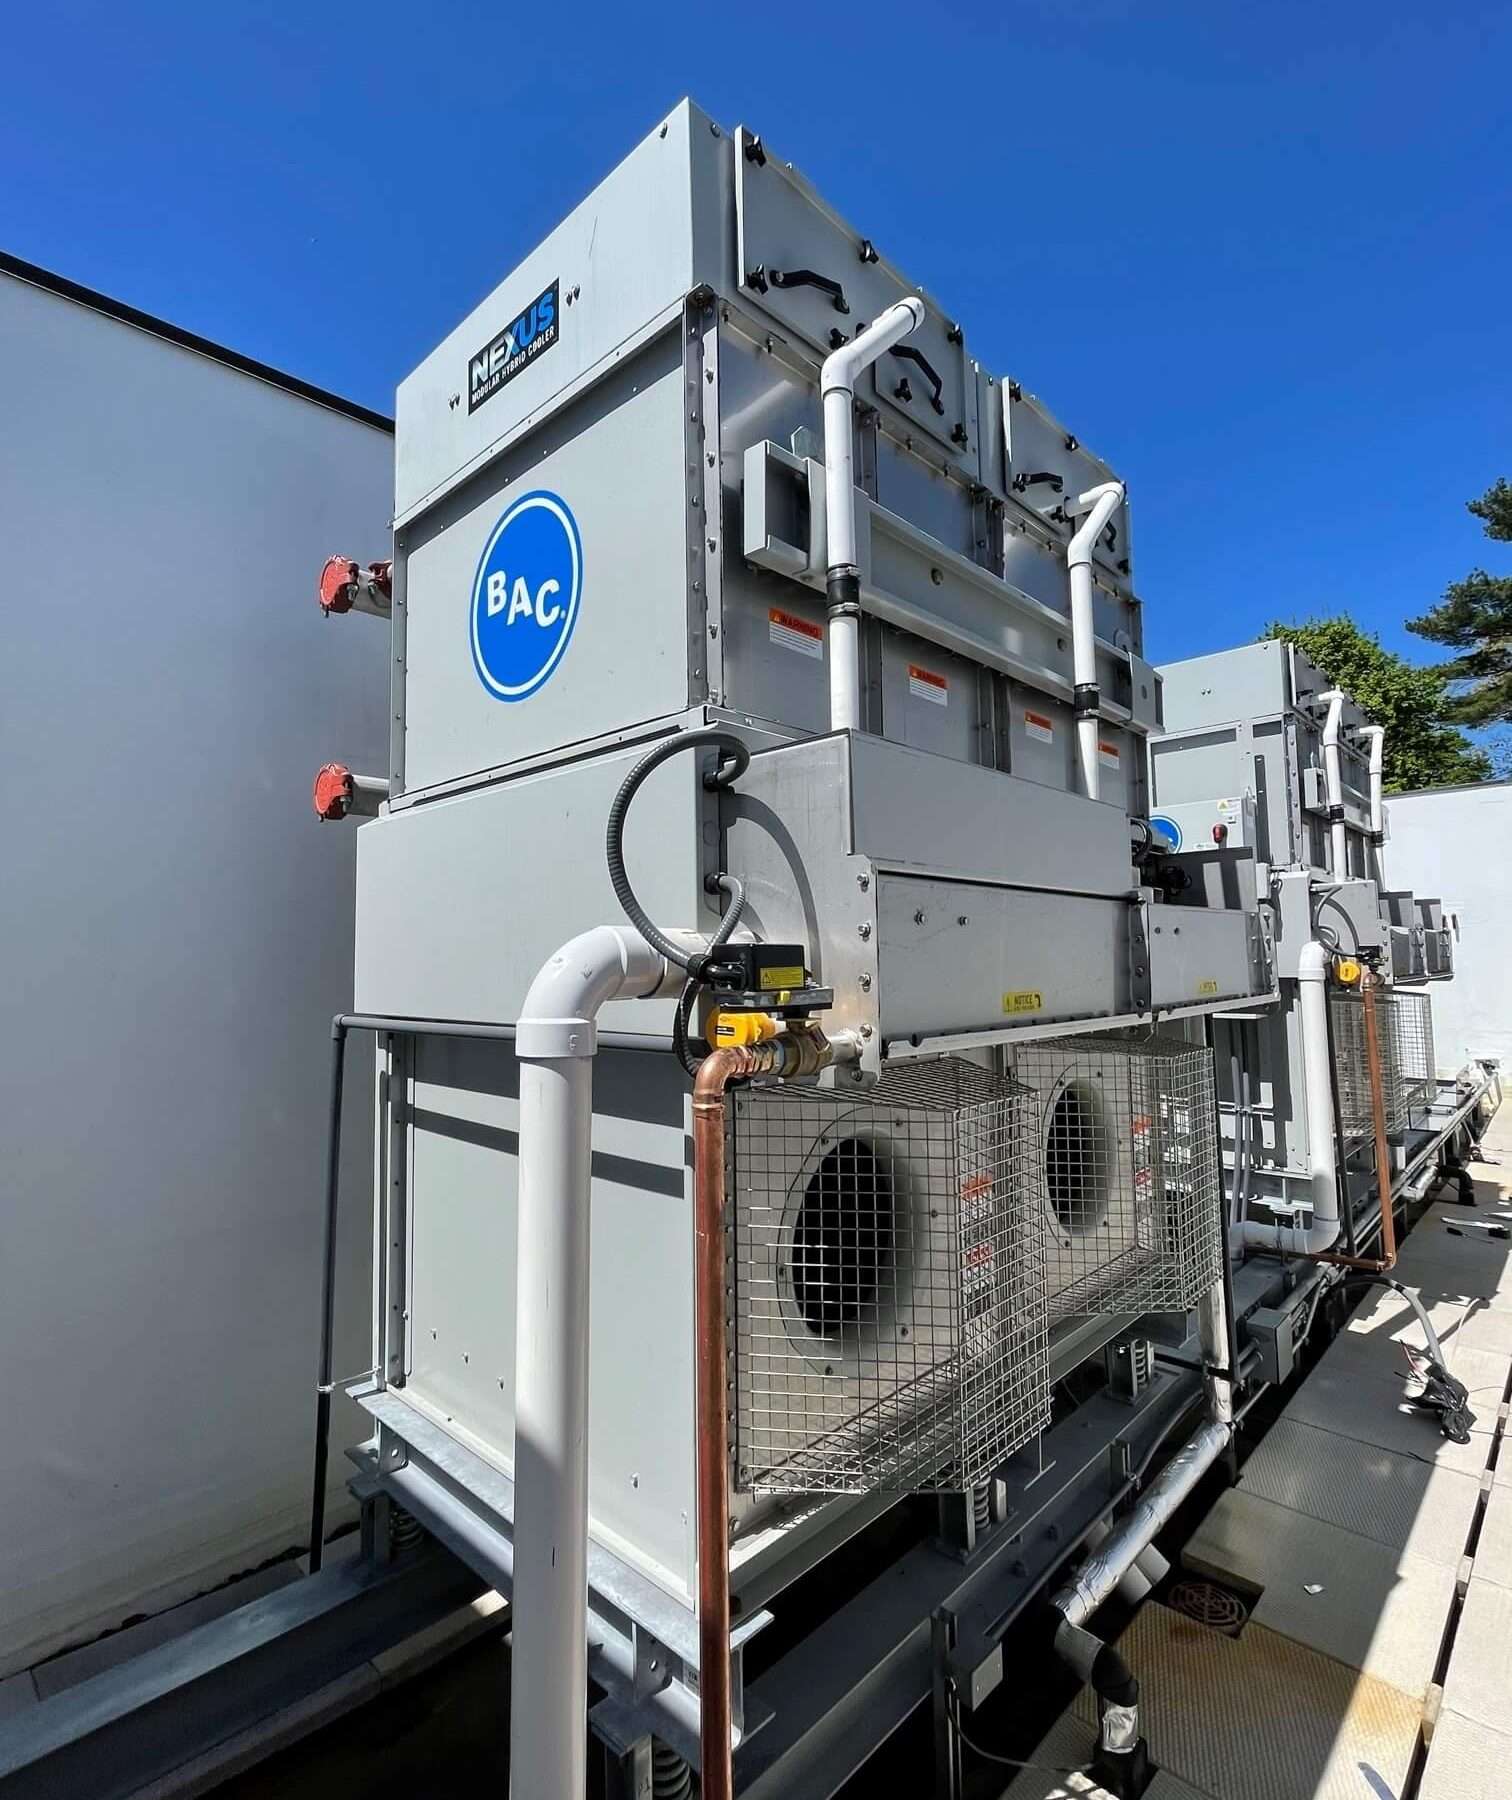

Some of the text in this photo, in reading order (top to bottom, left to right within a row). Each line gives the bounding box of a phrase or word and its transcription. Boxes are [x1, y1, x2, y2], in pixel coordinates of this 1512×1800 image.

[471, 325, 554, 404] MODULAR HYBRID COOLER
[472, 292, 554, 391] NEXUS
